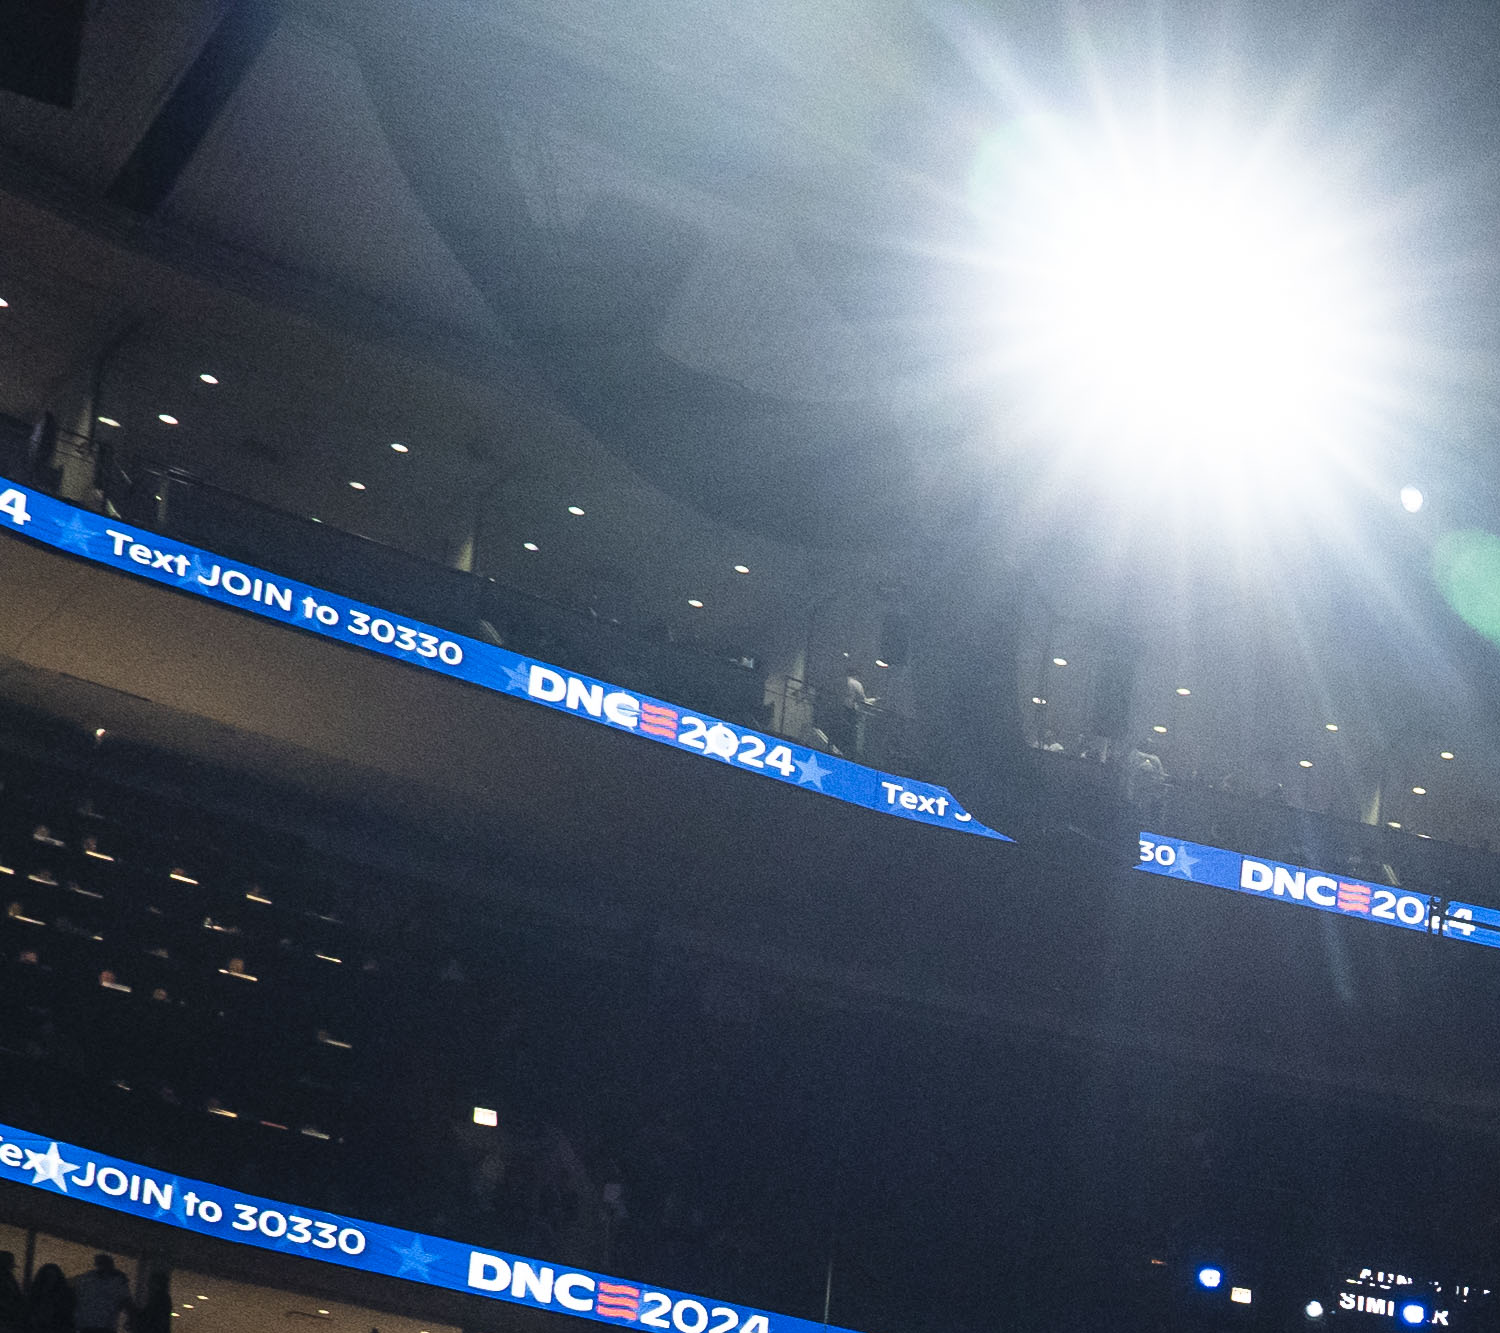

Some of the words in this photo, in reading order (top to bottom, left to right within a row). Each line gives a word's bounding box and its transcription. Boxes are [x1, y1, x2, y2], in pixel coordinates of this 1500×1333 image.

[106, 529, 191, 577] Text
[197, 565, 292, 611] JOIN
[302, 596, 339, 626] to
[347, 609, 463, 665] 30330
[528, 665, 640, 731] DNC
[678, 716, 795, 777] 2024
[881, 781, 949, 817] Text
[1240, 859, 1338, 907] DNC
[71, 1162, 173, 1210] JOIN
[183, 1191, 223, 1223] to
[232, 1203, 366, 1255] 30330
[467, 1251, 596, 1312] DNC
